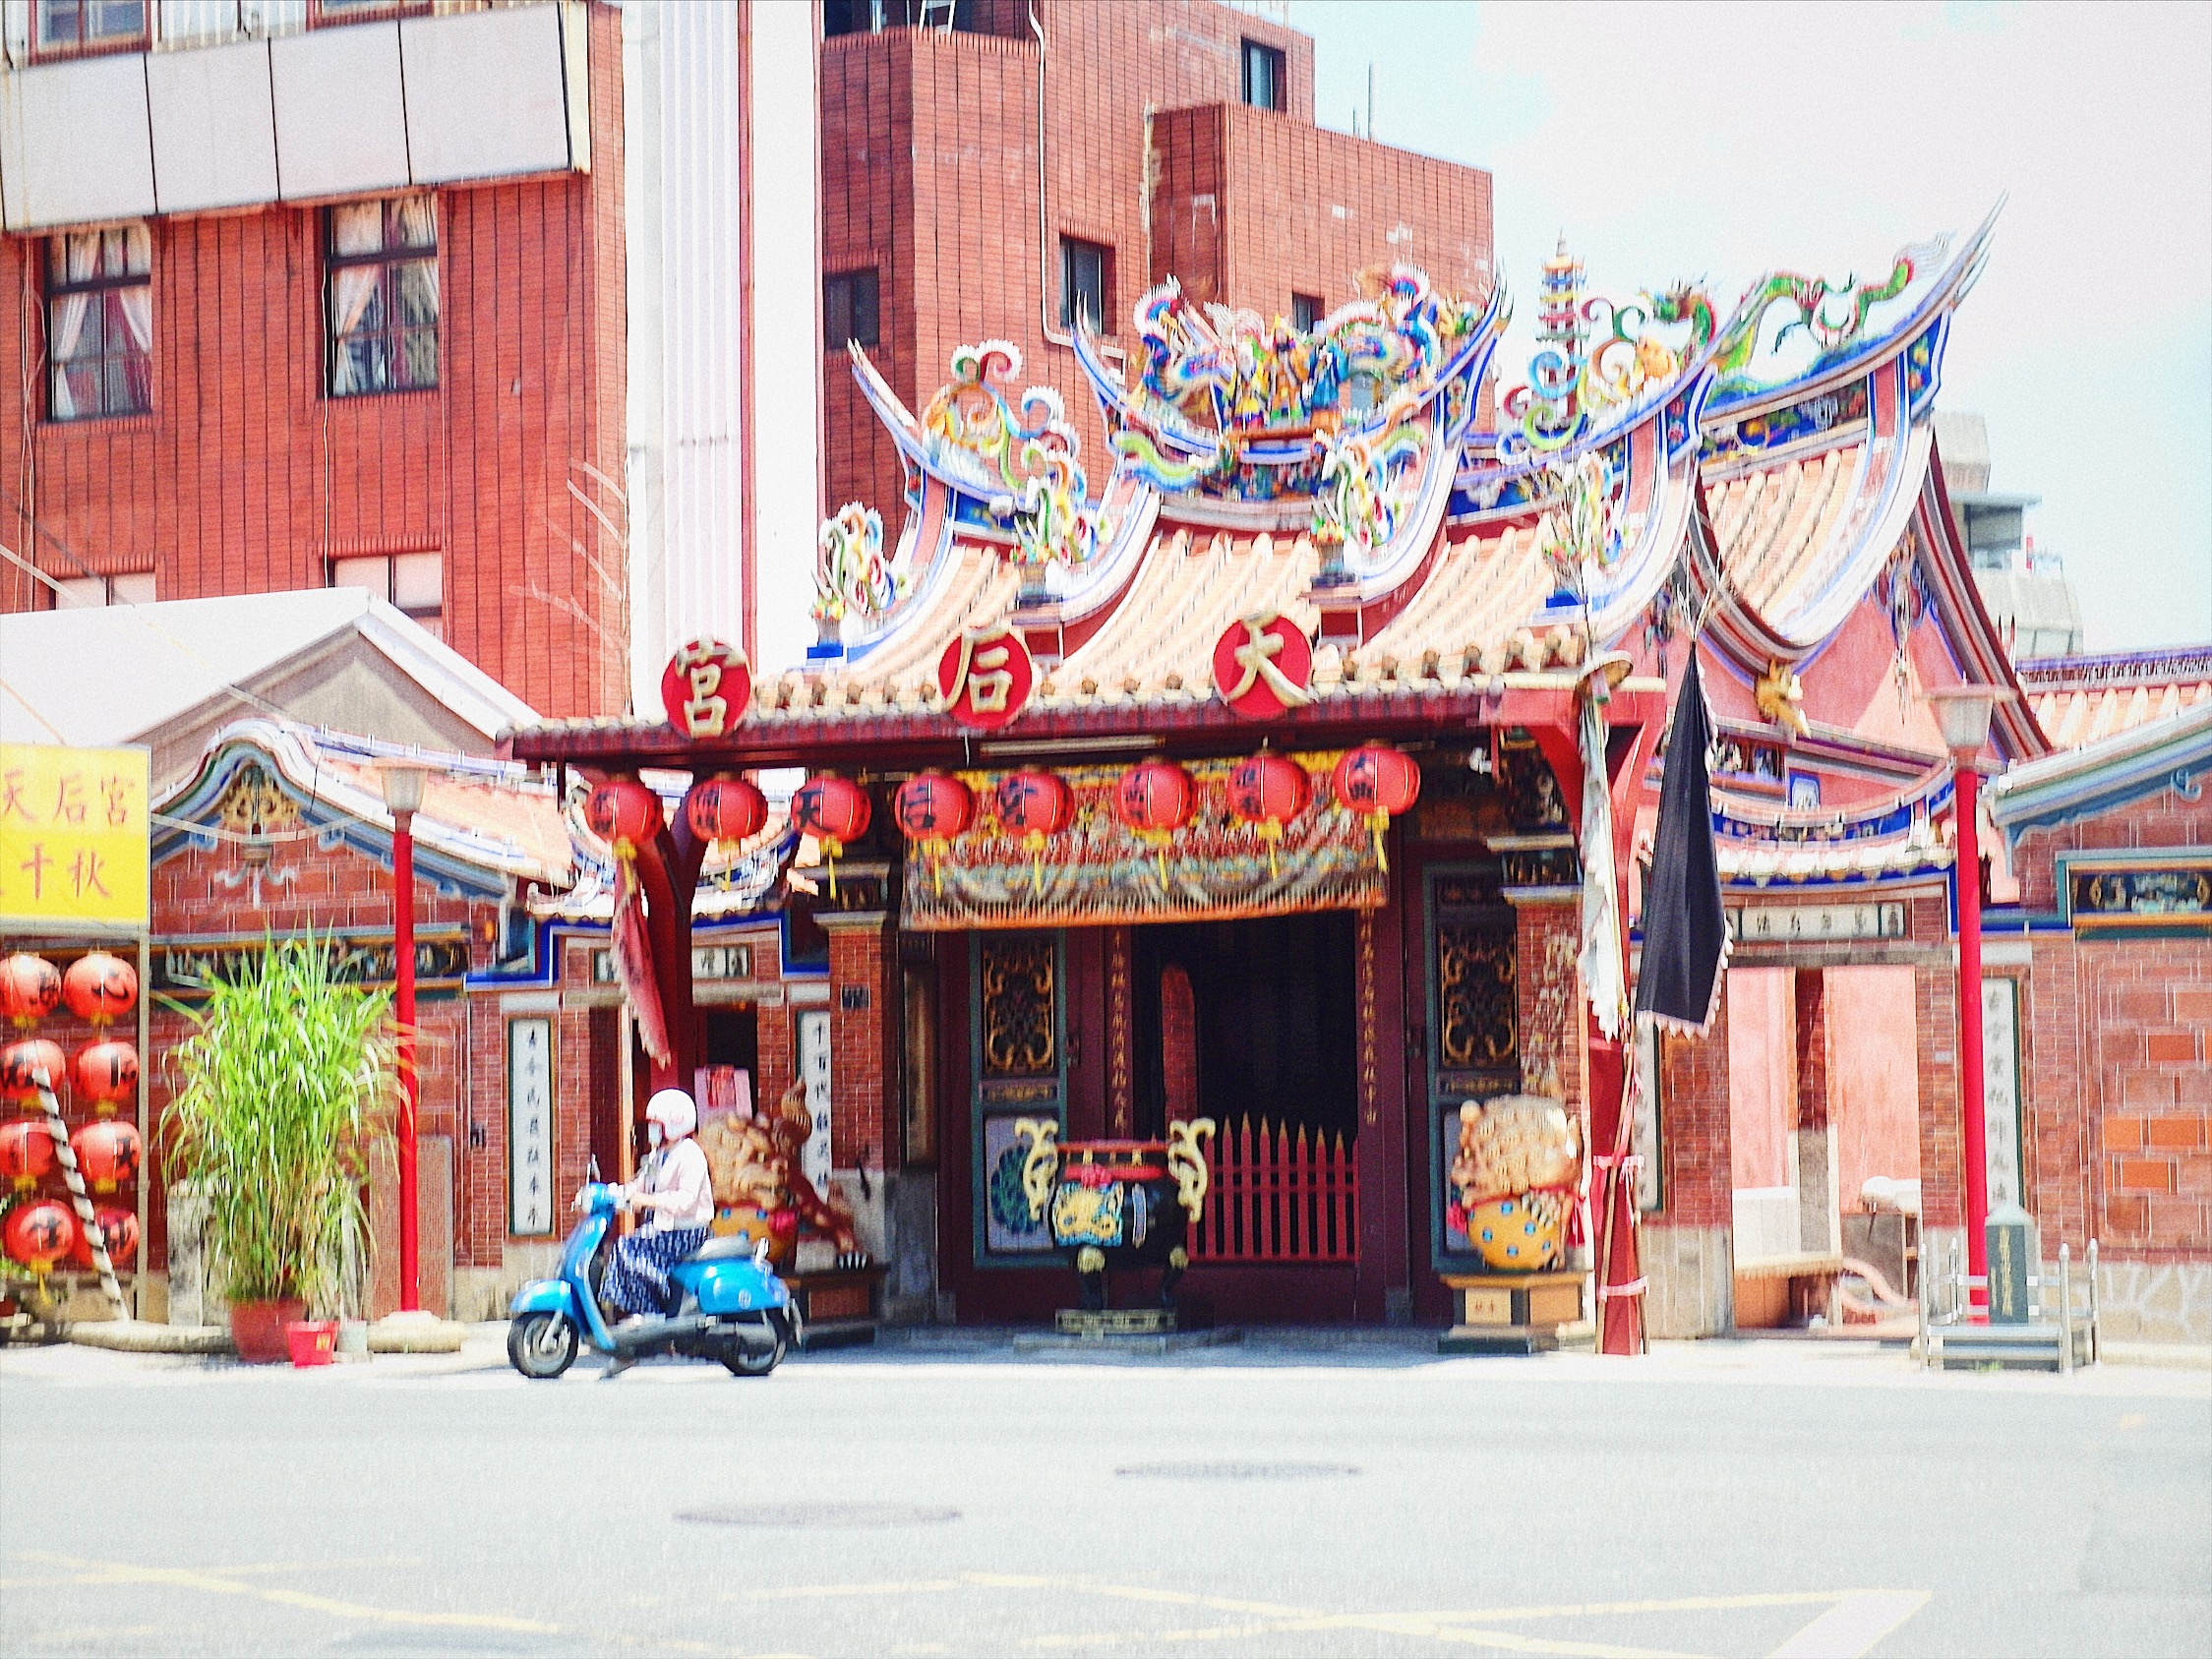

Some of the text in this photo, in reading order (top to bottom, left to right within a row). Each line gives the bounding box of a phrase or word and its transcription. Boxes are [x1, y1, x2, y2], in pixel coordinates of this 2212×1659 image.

[676, 608, 1319, 738] 天 后 宮
[1, 767, 136, 826] 天后宮
[0, 843, 111, 899] 千秋
